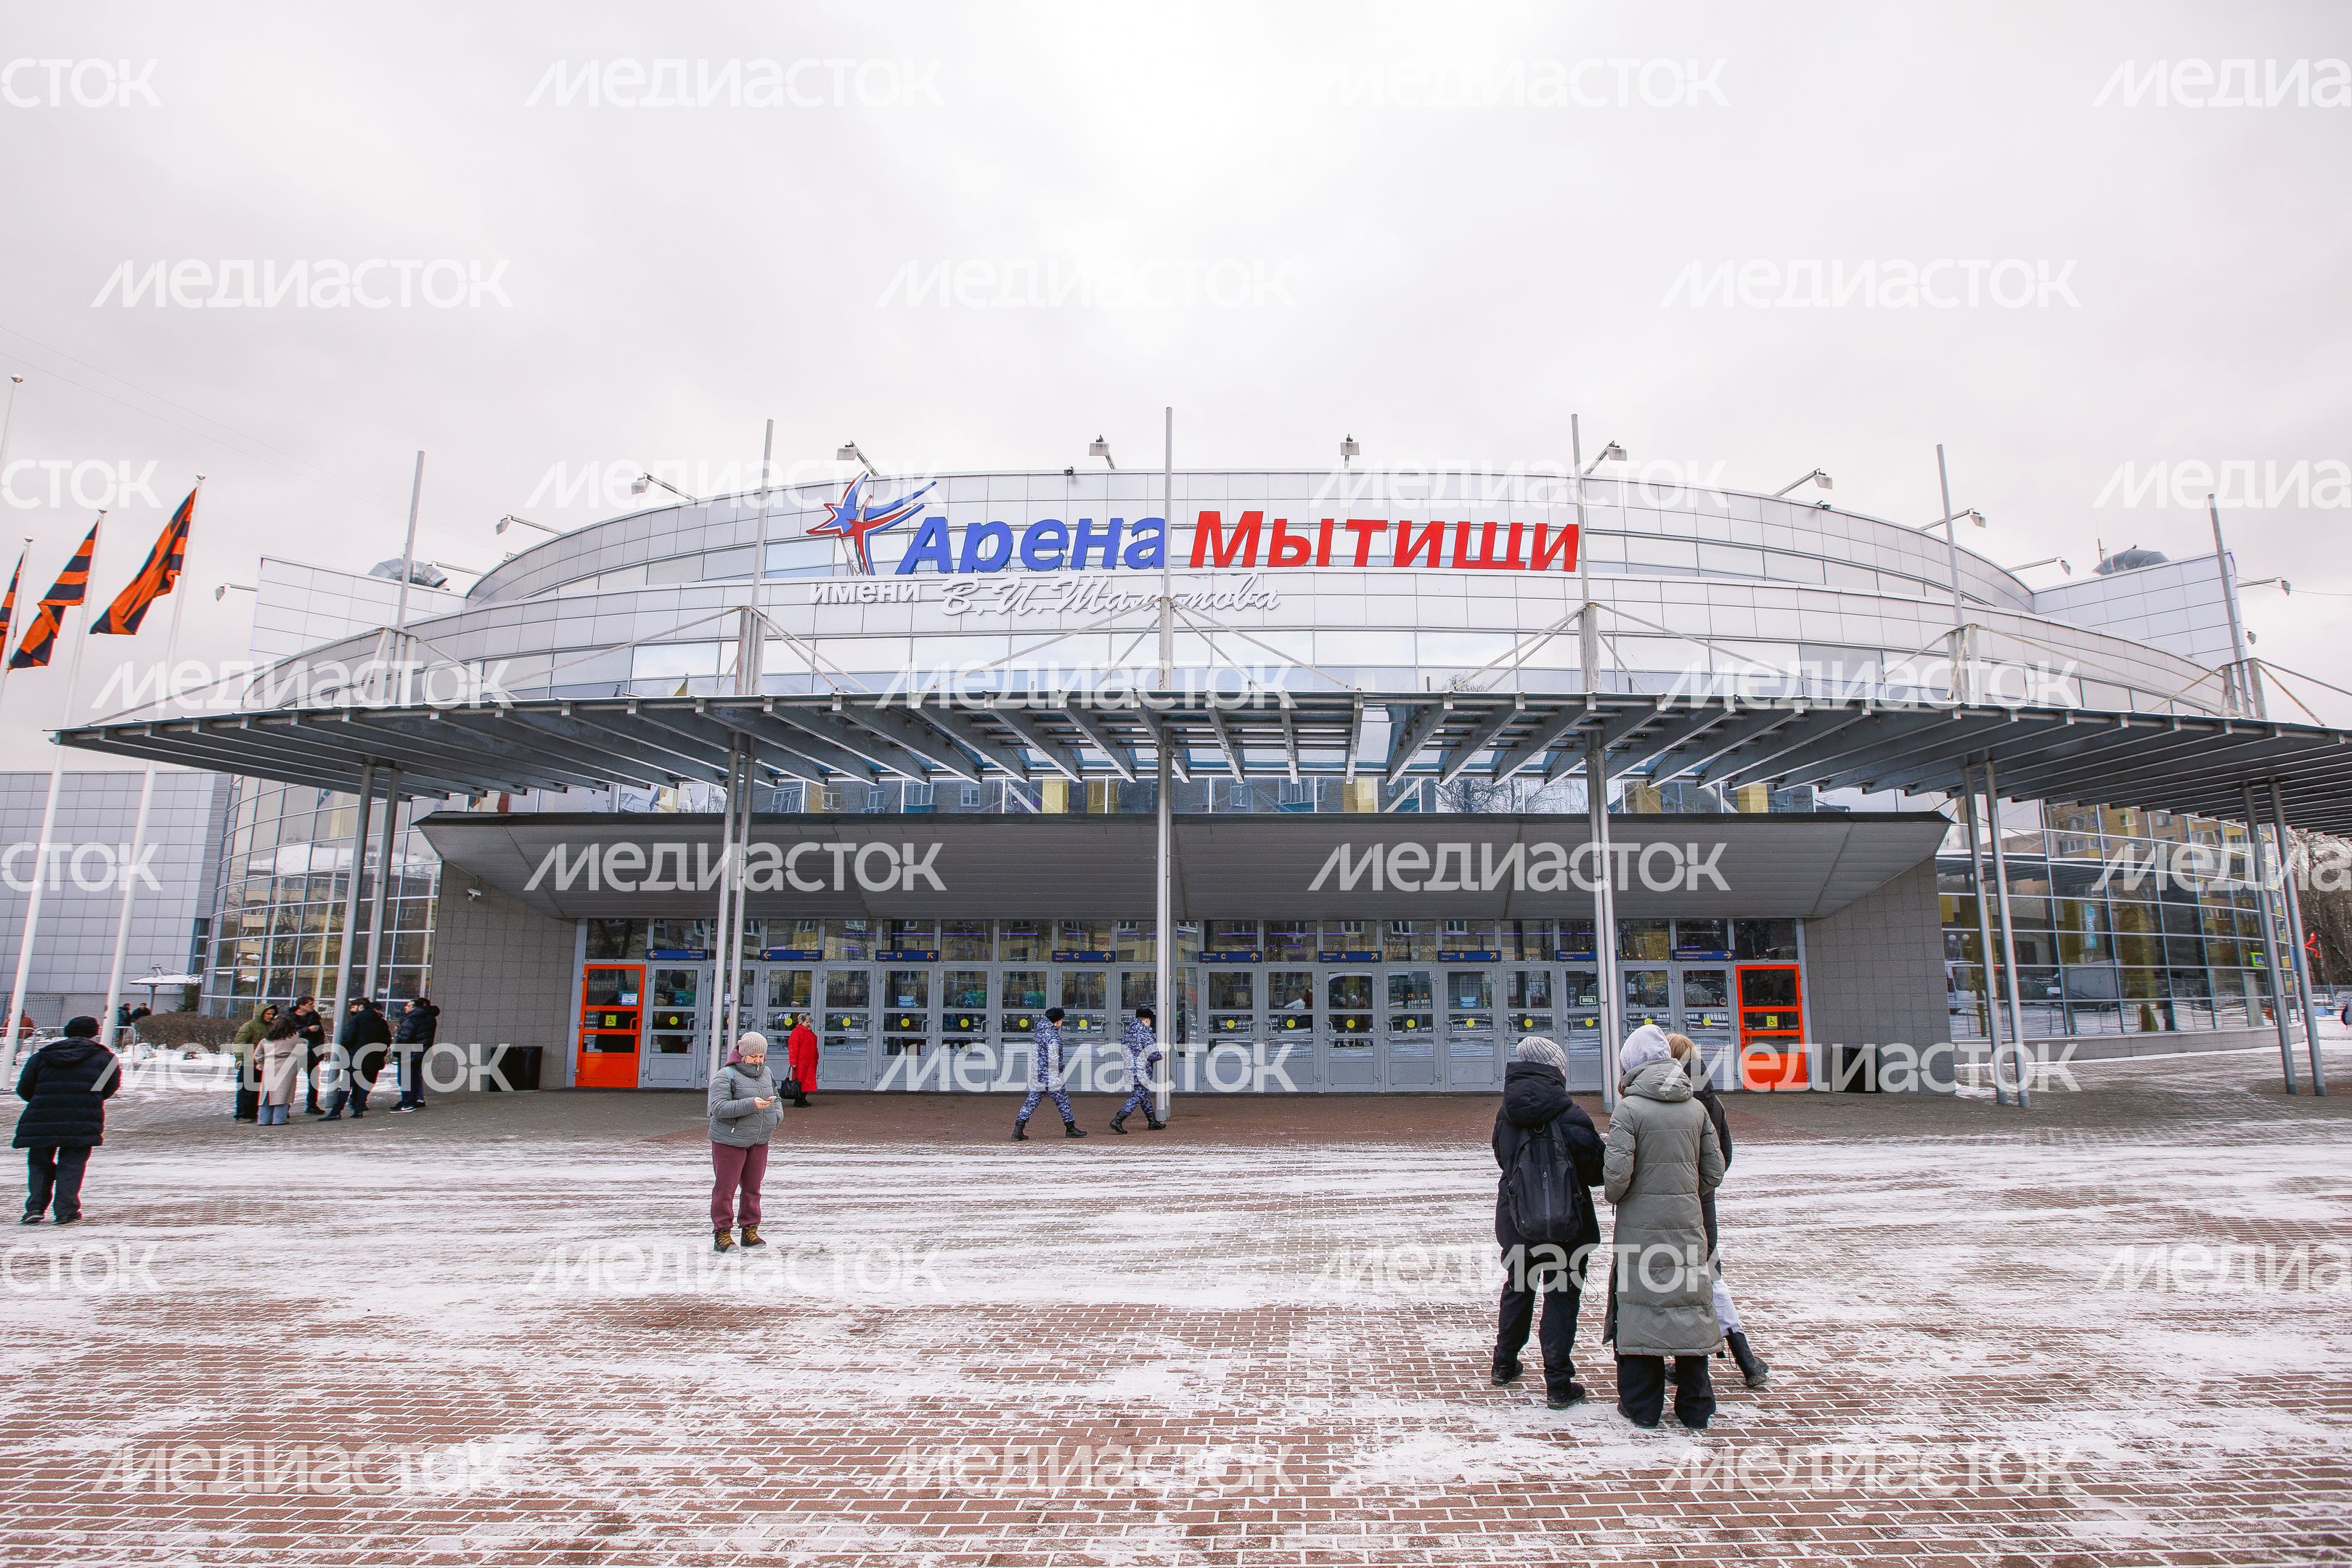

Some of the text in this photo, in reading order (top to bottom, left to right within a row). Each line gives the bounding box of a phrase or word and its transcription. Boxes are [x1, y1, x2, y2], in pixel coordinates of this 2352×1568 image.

[895, 510, 1580, 575] Арена Мытищи
[809, 581, 922, 604] имени
